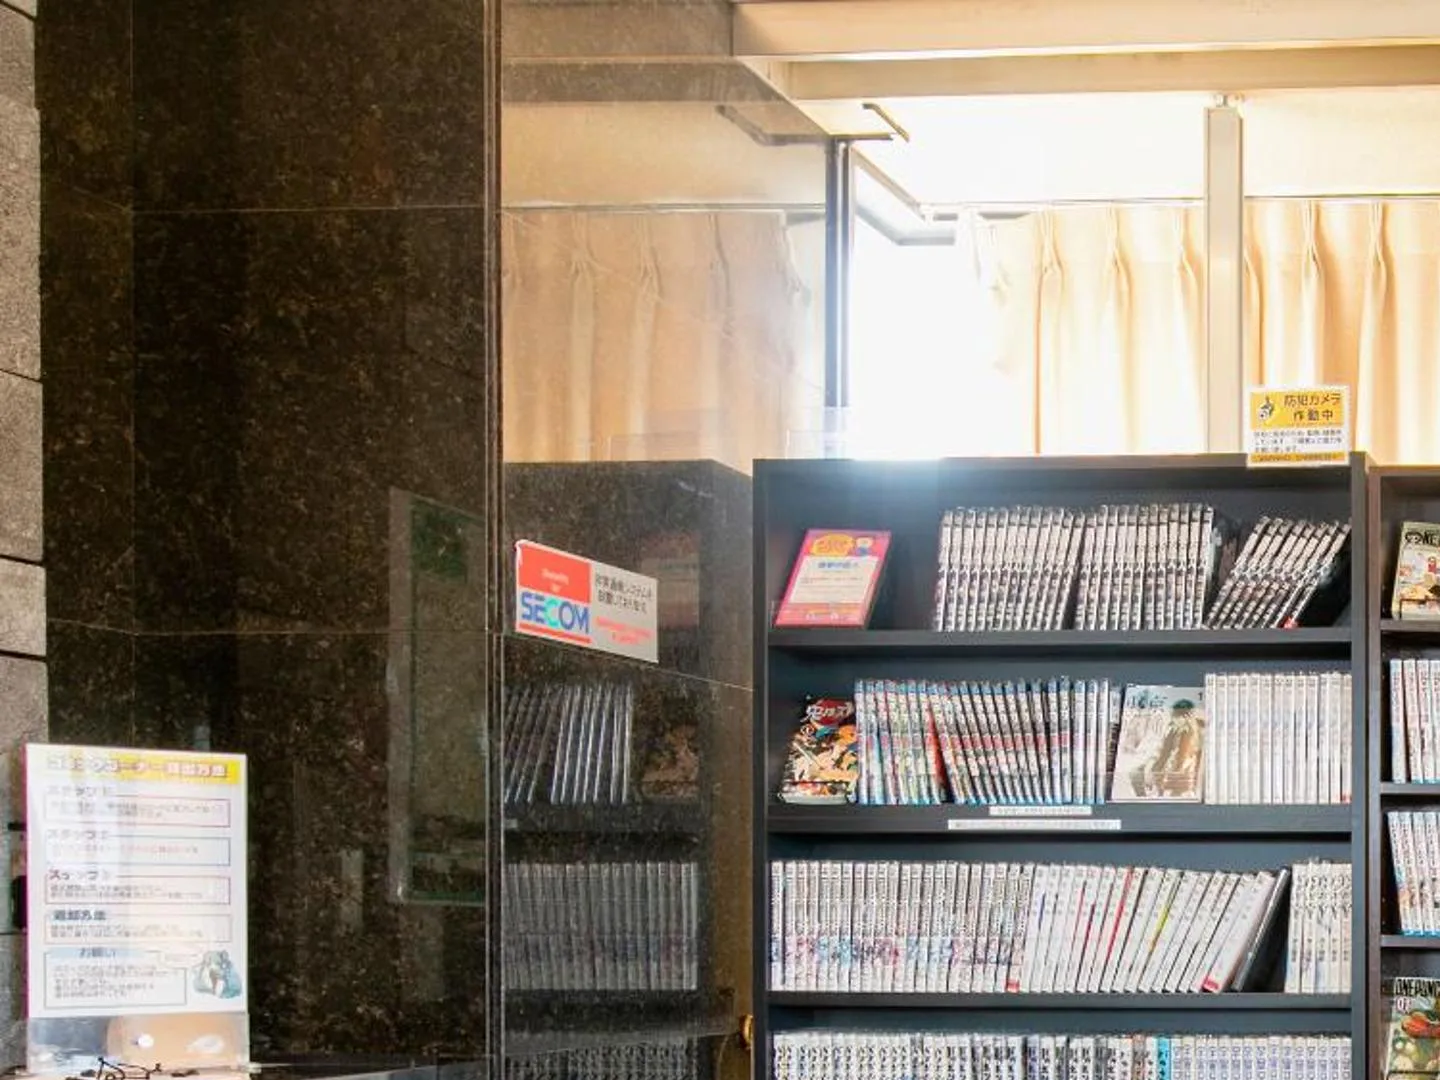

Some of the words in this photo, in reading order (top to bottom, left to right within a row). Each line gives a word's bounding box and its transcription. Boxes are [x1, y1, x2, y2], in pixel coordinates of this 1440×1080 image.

[1284, 393, 1341, 408] 防犯カメラ
[1293, 409, 1334, 422] 作動中
[521, 591, 589, 634] SECOM
